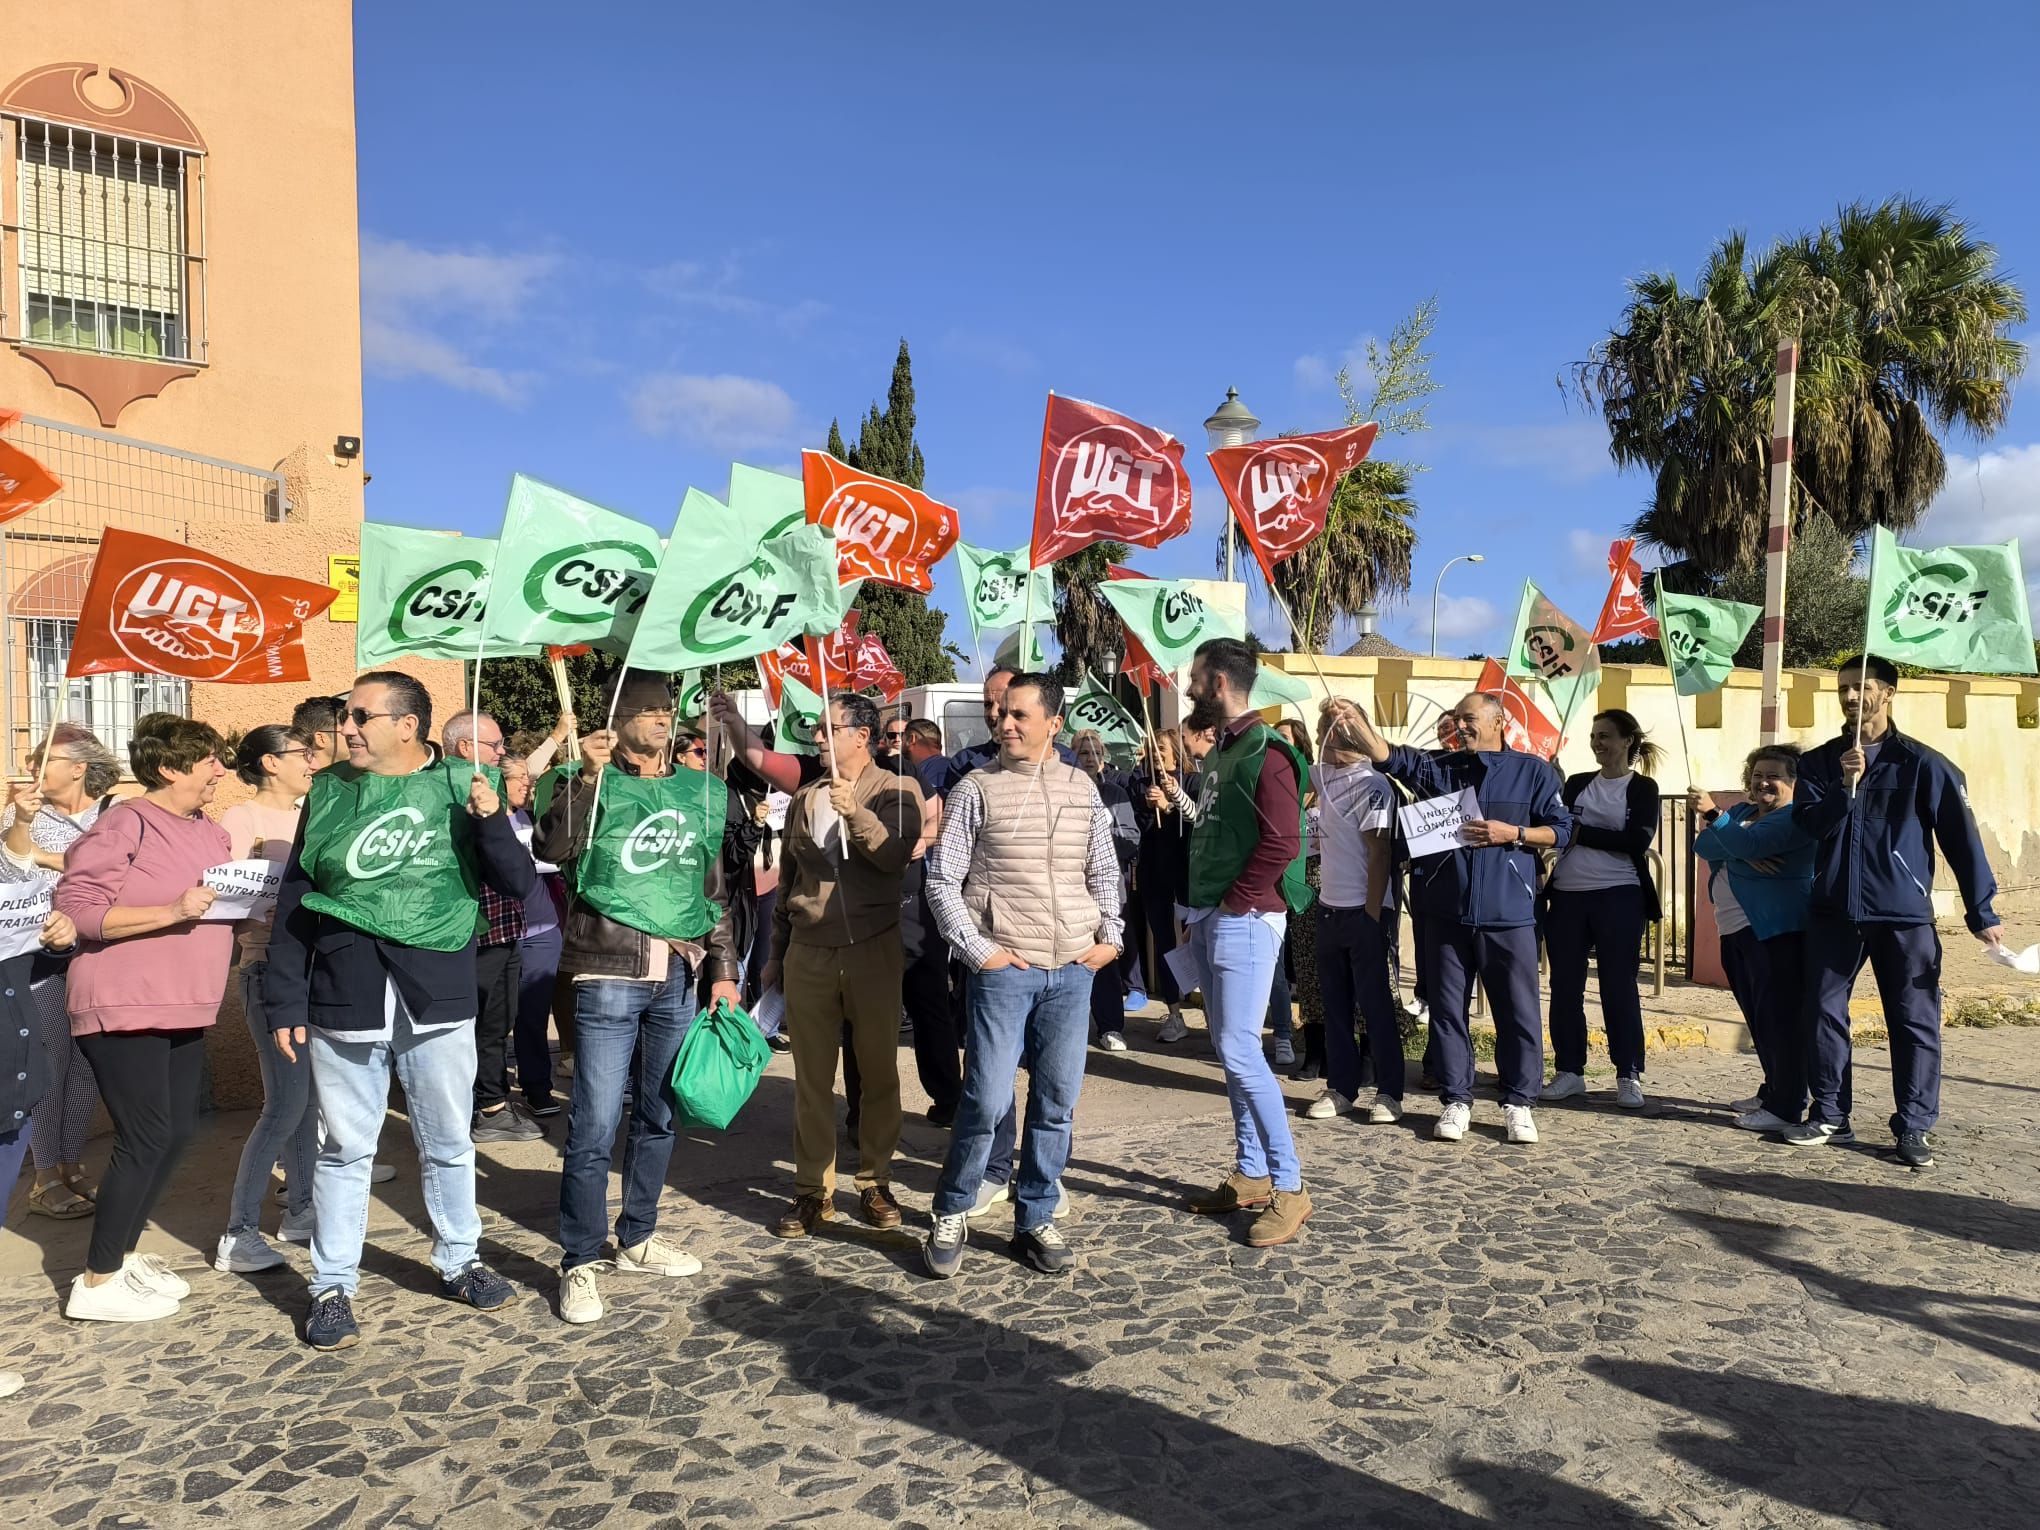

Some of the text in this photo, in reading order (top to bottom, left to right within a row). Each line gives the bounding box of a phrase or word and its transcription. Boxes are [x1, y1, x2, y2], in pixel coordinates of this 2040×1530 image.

[1070, 441, 1164, 508] UGT
[832, 494, 910, 556] UGT
[127, 571, 249, 642] UGT
[234, 869, 280, 886] PLIEGO
